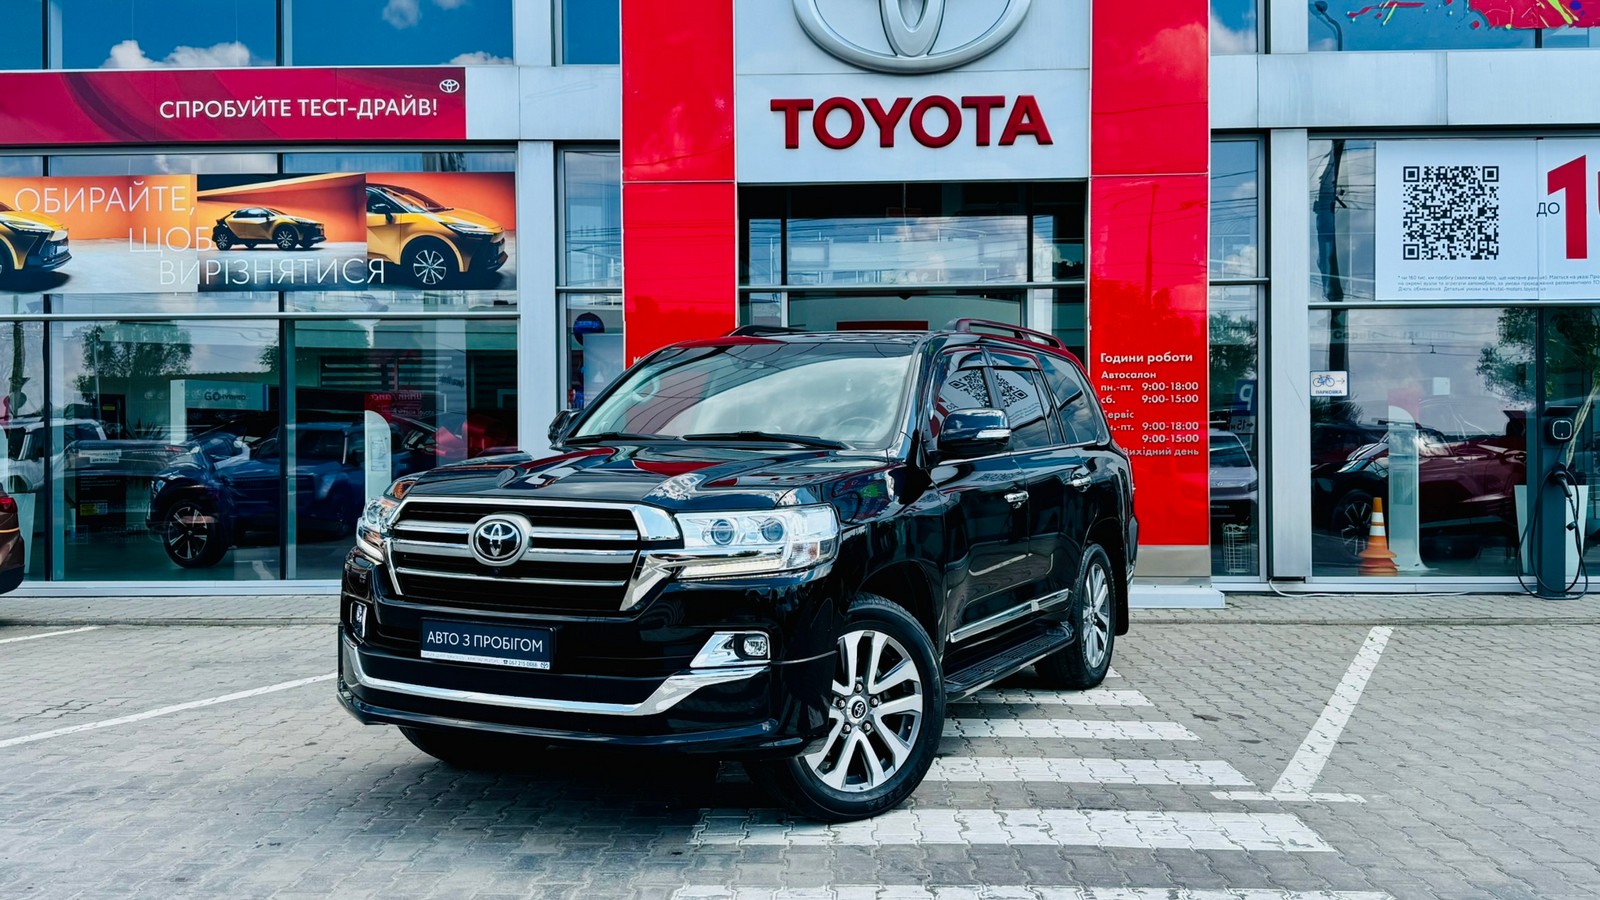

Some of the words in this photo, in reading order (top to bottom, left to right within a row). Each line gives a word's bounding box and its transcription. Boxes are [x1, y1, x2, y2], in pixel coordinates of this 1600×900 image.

[159, 96, 291, 119] СПРОБУЙТЕ
[297, 94, 438, 119] ТЕСТ-ДРАЙВ!
[770, 95, 1053, 150] TOYOTA
[15, 181, 195, 215] ОБИРАЙТЕ,
[128, 227, 212, 258] ЩОБ
[159, 258, 385, 286] ВИРІЗНЯТИСЯ
[1100, 352, 1143, 364] Години
[1147, 351, 1193, 365] роботи
[1101, 371, 1156, 379] Автосалон
[1100, 395, 1116, 404] сб.
[1174, 448, 1199, 457] день
[427, 631, 459, 645] АВТО
[474, 634, 543, 653] ПРОБІГОМ
